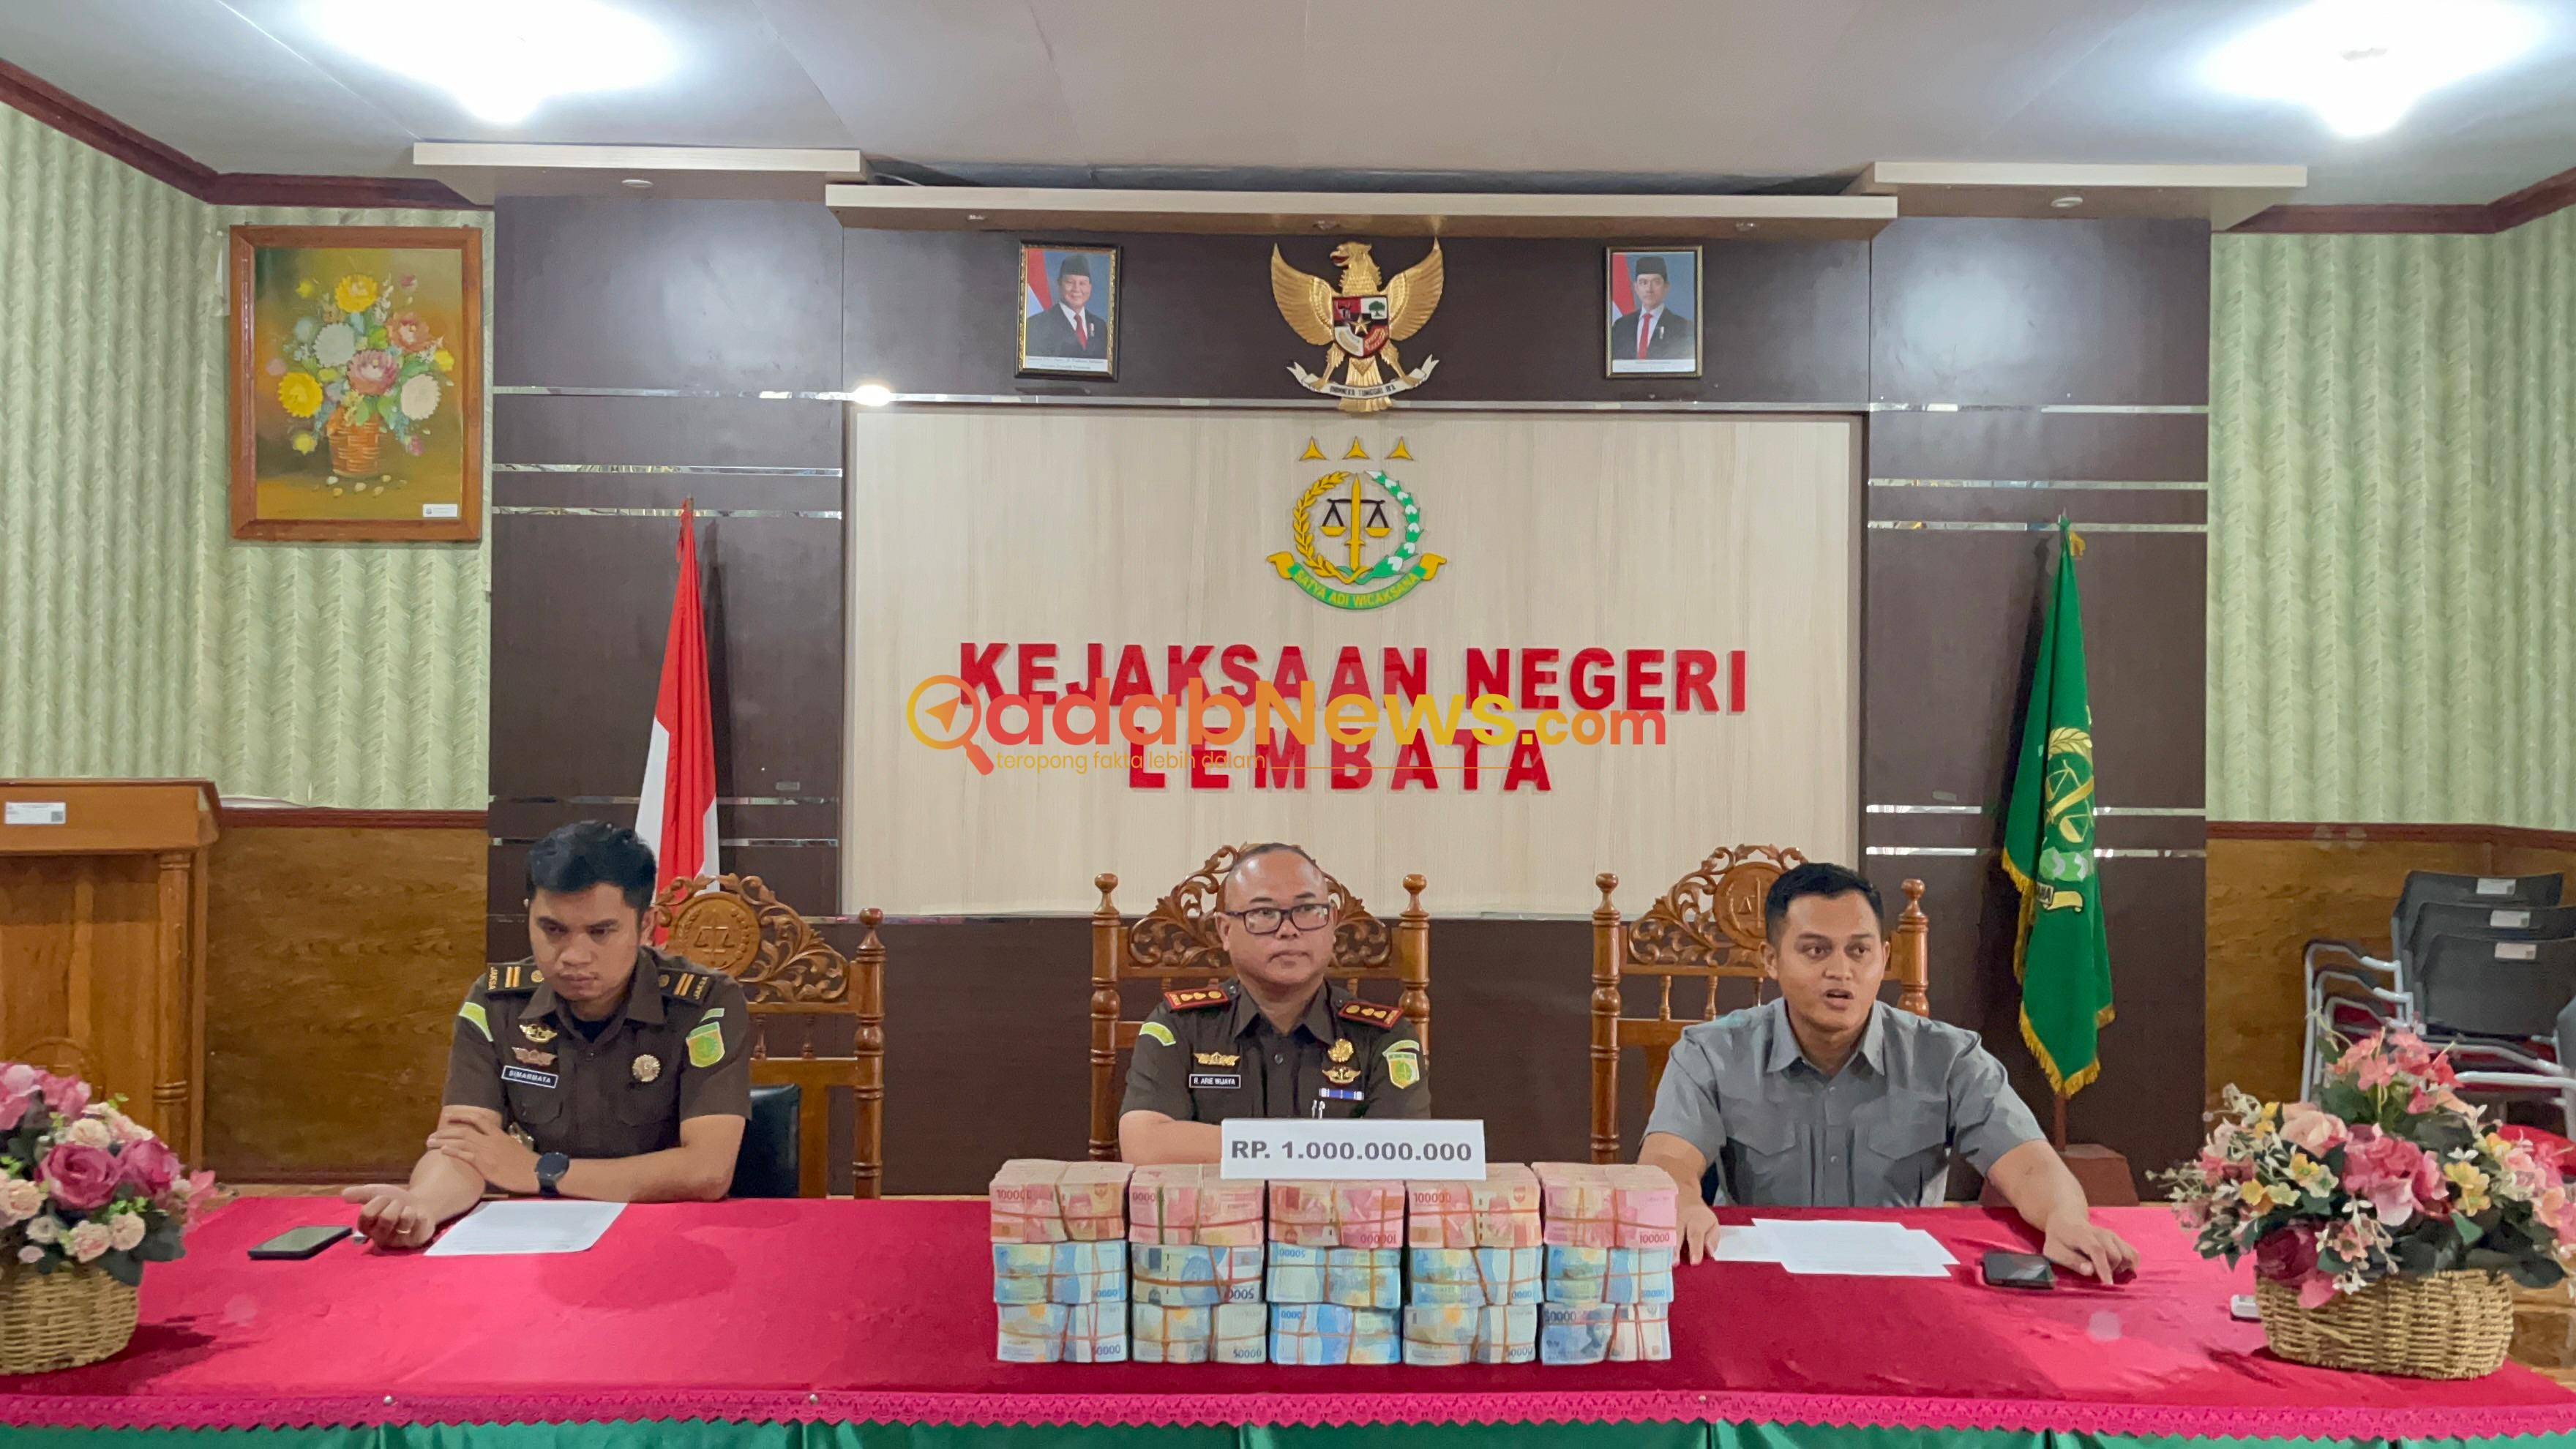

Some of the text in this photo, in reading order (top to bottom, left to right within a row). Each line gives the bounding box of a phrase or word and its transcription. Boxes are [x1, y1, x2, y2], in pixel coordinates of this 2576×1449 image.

[1329, 593, 1349, 606] ADI
[960, 643, 1745, 712] KEJAKSAAN NEGERI
[1128, 727, 1551, 790] LEMBATA
[1231, 1140, 1472, 1161] RP. 1.000.000.000
[1511, 1290, 1532, 1299] 0000
[1096, 1344, 1121, 1356] 0000
[1509, 1347, 1533, 1358] 0000
